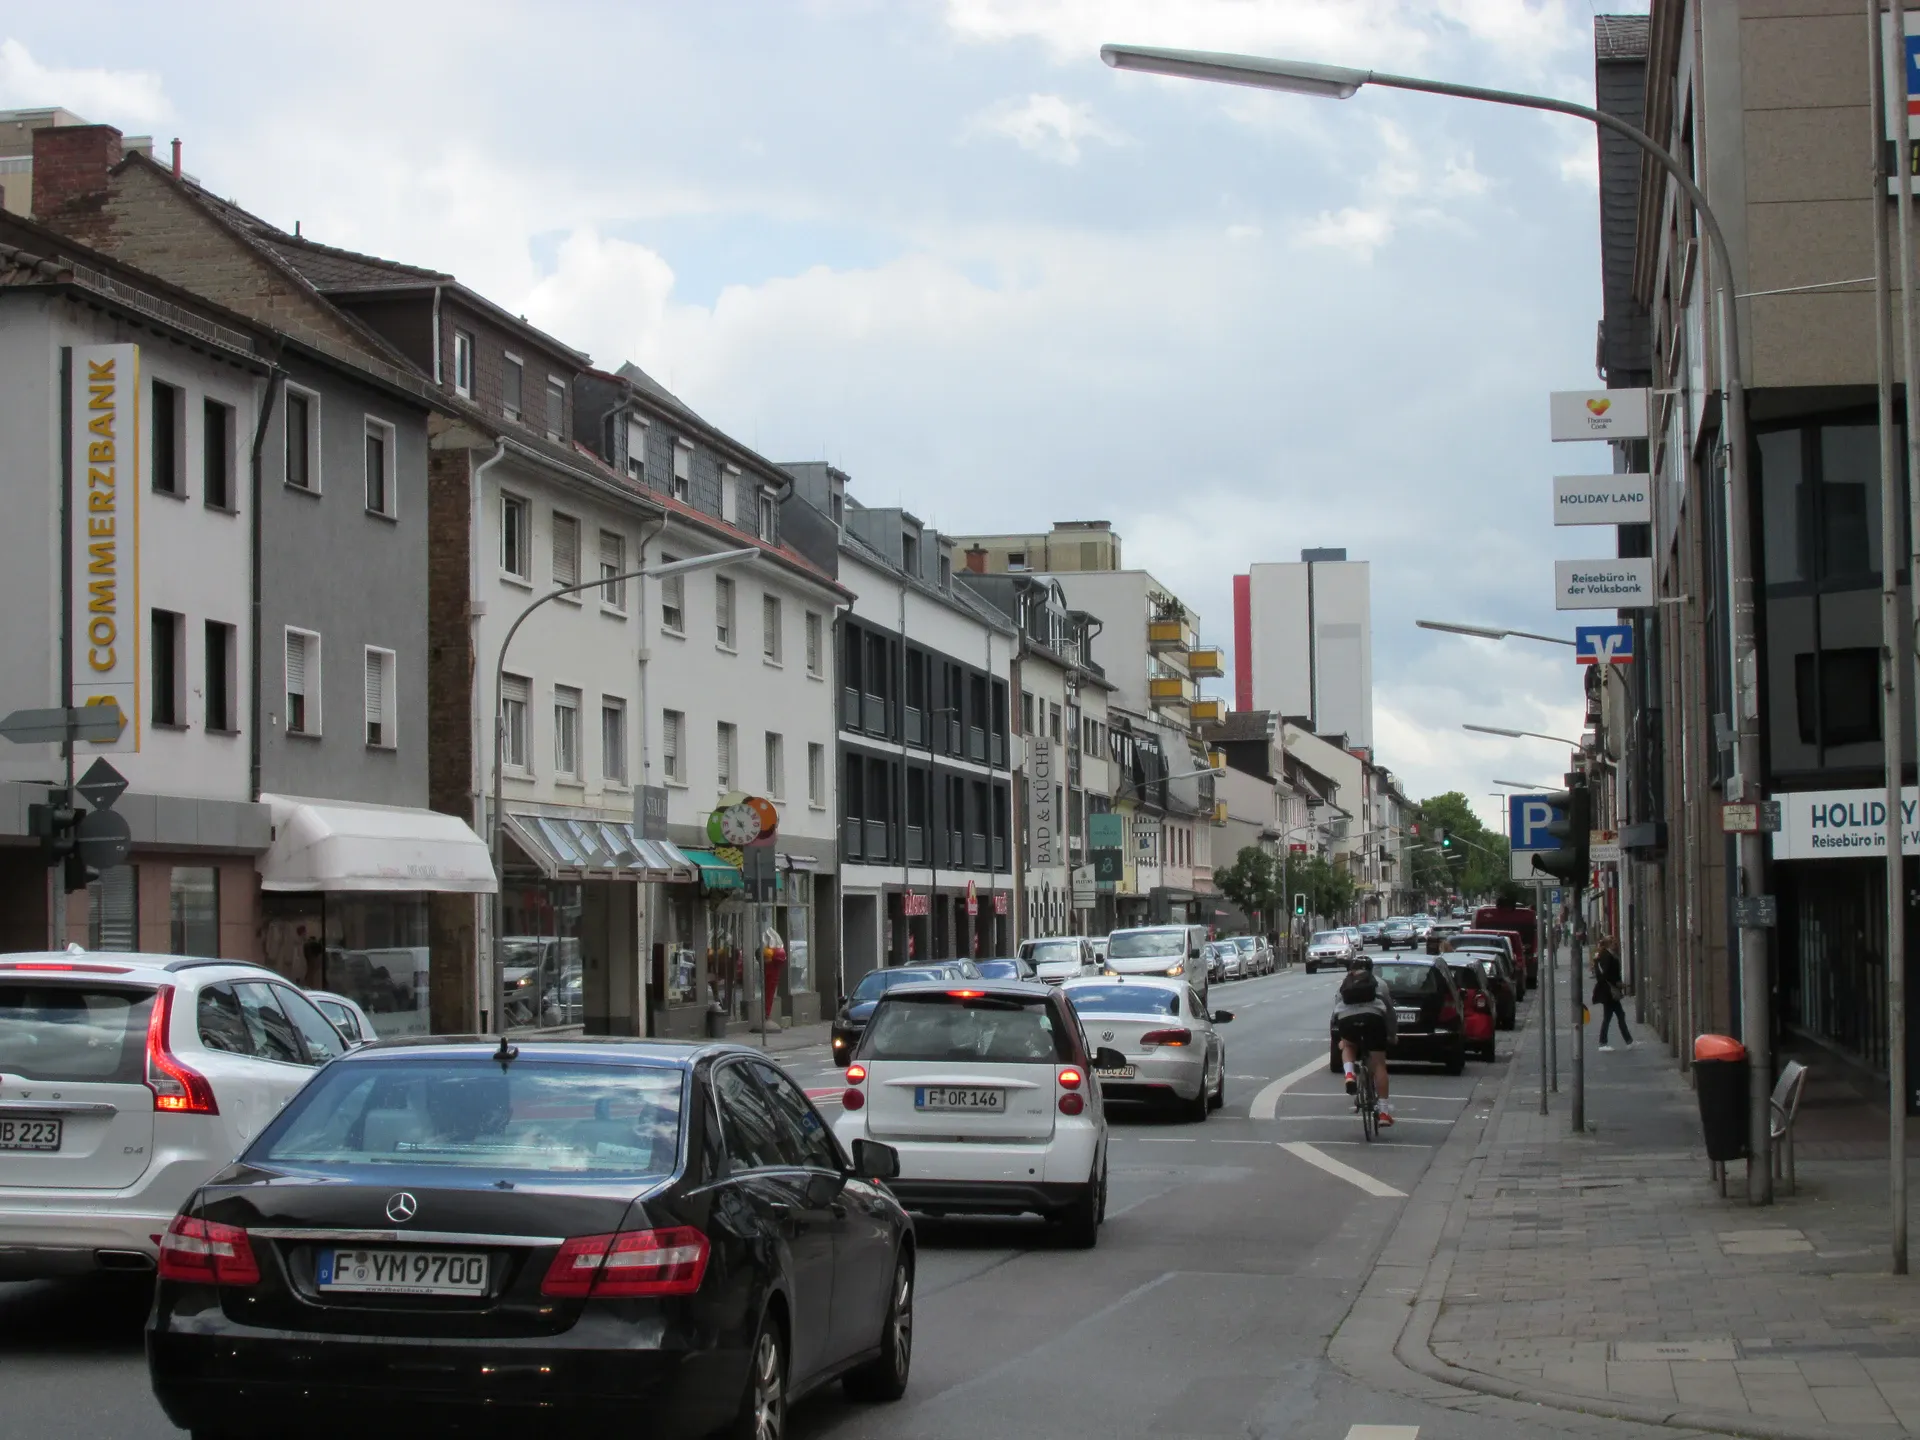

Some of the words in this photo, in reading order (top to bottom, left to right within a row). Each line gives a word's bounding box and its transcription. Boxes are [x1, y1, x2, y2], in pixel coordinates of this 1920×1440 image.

[1560, 493, 1610, 504] HOLIDAY
[1612, 493, 1644, 503] LAND
[88, 358, 117, 673] COMMERZBANK
[1571, 573, 1624, 584] Reisebüro
[1626, 573, 1637, 582] in
[1567, 584, 1586, 595] der
[1587, 583, 1642, 595] Volksbank
[1033, 741, 1050, 804] KÜCHE
[1036, 808, 1050, 821] &
[1811, 800, 1917, 829] HOLIDY
[1523, 802, 1553, 845] P
[1037, 827, 1051, 864] BAD
[1811, 832, 1872, 848] Reisebüro
[1874, 832, 1885, 846] in
[929, 1091, 938, 1105] F
[948, 1091, 967, 1106] OR
[970, 1092, 997, 1106] 146
[20, 1123, 56, 1142] 223
[124, 1146, 144, 1154] D4
[334, 1254, 353, 1280] F
[373, 1254, 408, 1282] YM
[414, 1256, 483, 1285] 9700
